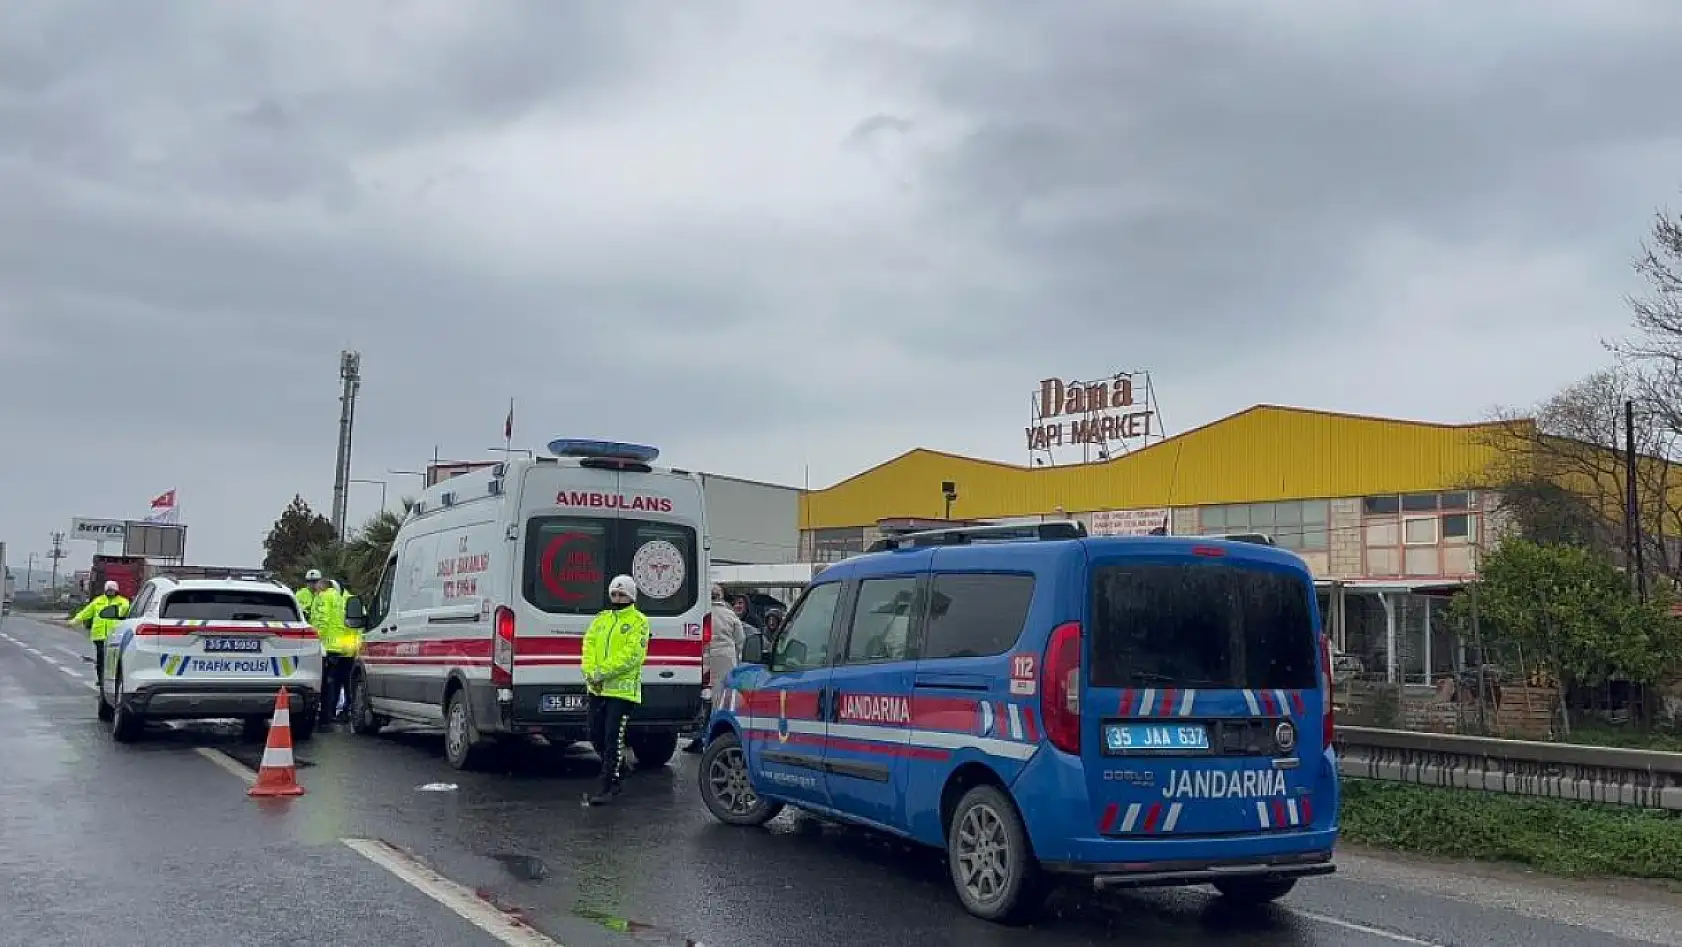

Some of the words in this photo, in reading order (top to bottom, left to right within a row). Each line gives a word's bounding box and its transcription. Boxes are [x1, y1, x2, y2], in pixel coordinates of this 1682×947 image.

[1025, 421, 1063, 450] YAPI
[1071, 411, 1154, 444] MARKET
[556, 491, 672, 512] AMBULANS
[192, 658, 231, 672] TRAFİK
[1014, 656, 1034, 678] 112
[840, 695, 911, 723] JANDARMA
[1113, 728, 1132, 745] 35
[1144, 728, 1171, 745] JAA
[1177, 727, 1202, 744] 637
[1162, 769, 1287, 799] JANDARMA
